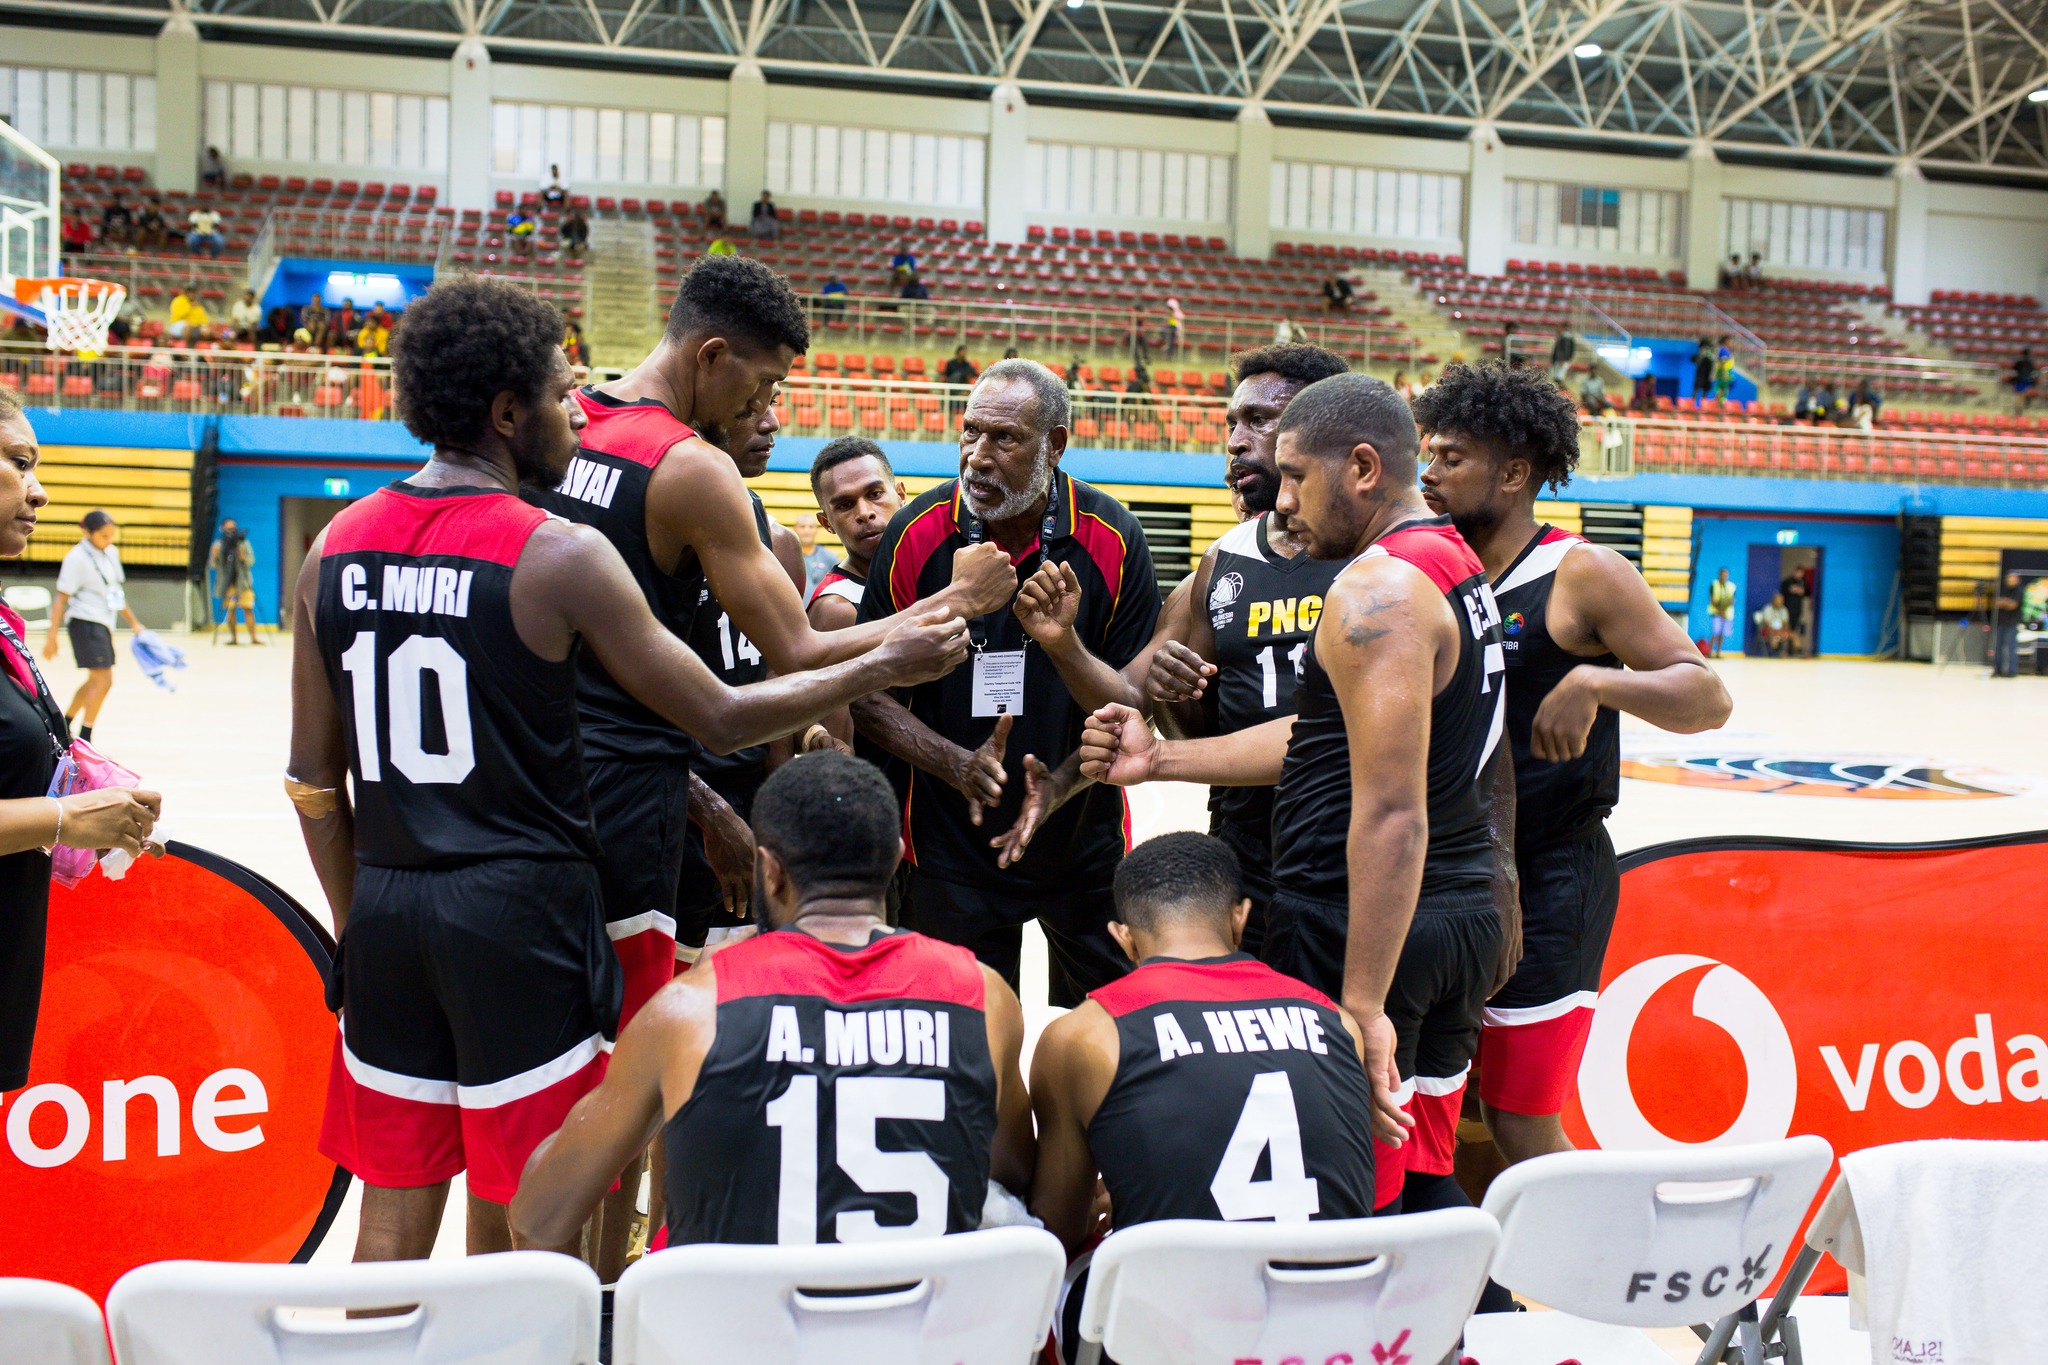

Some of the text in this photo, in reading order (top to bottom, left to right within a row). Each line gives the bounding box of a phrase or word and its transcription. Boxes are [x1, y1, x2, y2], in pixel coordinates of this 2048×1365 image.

[341, 563, 473, 618] C. MURI
[1247, 595, 1323, 637] PNG
[717, 611, 762, 670] 14
[1502, 640, 1519, 651] FIBA
[341, 631, 476, 784] 10
[765, 1005, 949, 1068] A. MURI
[1153, 1006, 1328, 1062] A. HEWE
[1818, 1013, 2048, 1111] voda
[0, 1068, 268, 1168] one
[1209, 1070, 1320, 1222] 4
[766, 1074, 949, 1245] 15
[1626, 1266, 1729, 1303] FSC
